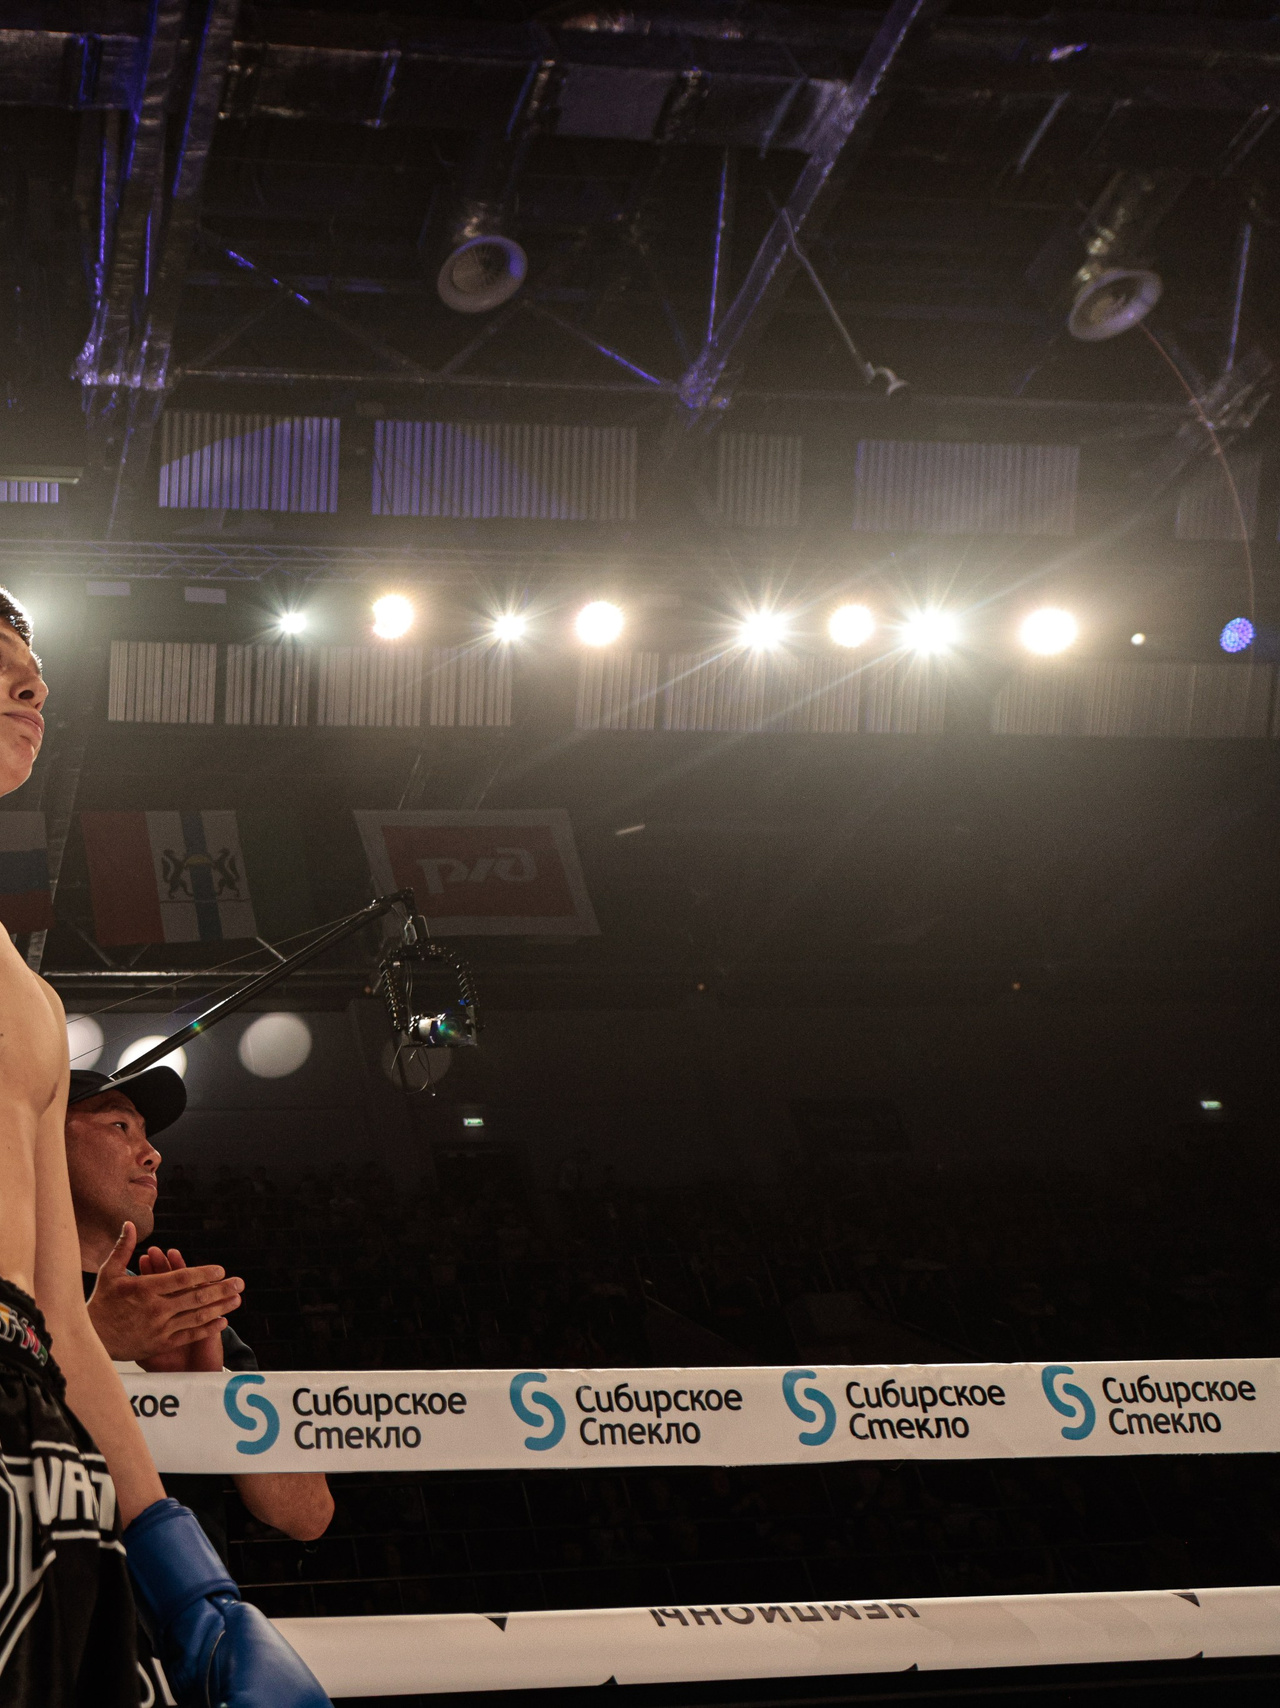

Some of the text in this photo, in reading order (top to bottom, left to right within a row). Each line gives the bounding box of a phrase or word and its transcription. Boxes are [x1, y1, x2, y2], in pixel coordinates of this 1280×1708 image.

[292, 1386, 467, 1421] Сибирское
[575, 1382, 743, 1418] Сибирское
[845, 1379, 1006, 1412] Сибирское
[1101, 1374, 1257, 1406] Сибирское
[293, 1420, 422, 1450] Стекло
[578, 1417, 701, 1446] Стекло
[849, 1412, 970, 1440] Стекло
[1108, 1408, 1222, 1435] Стекло
